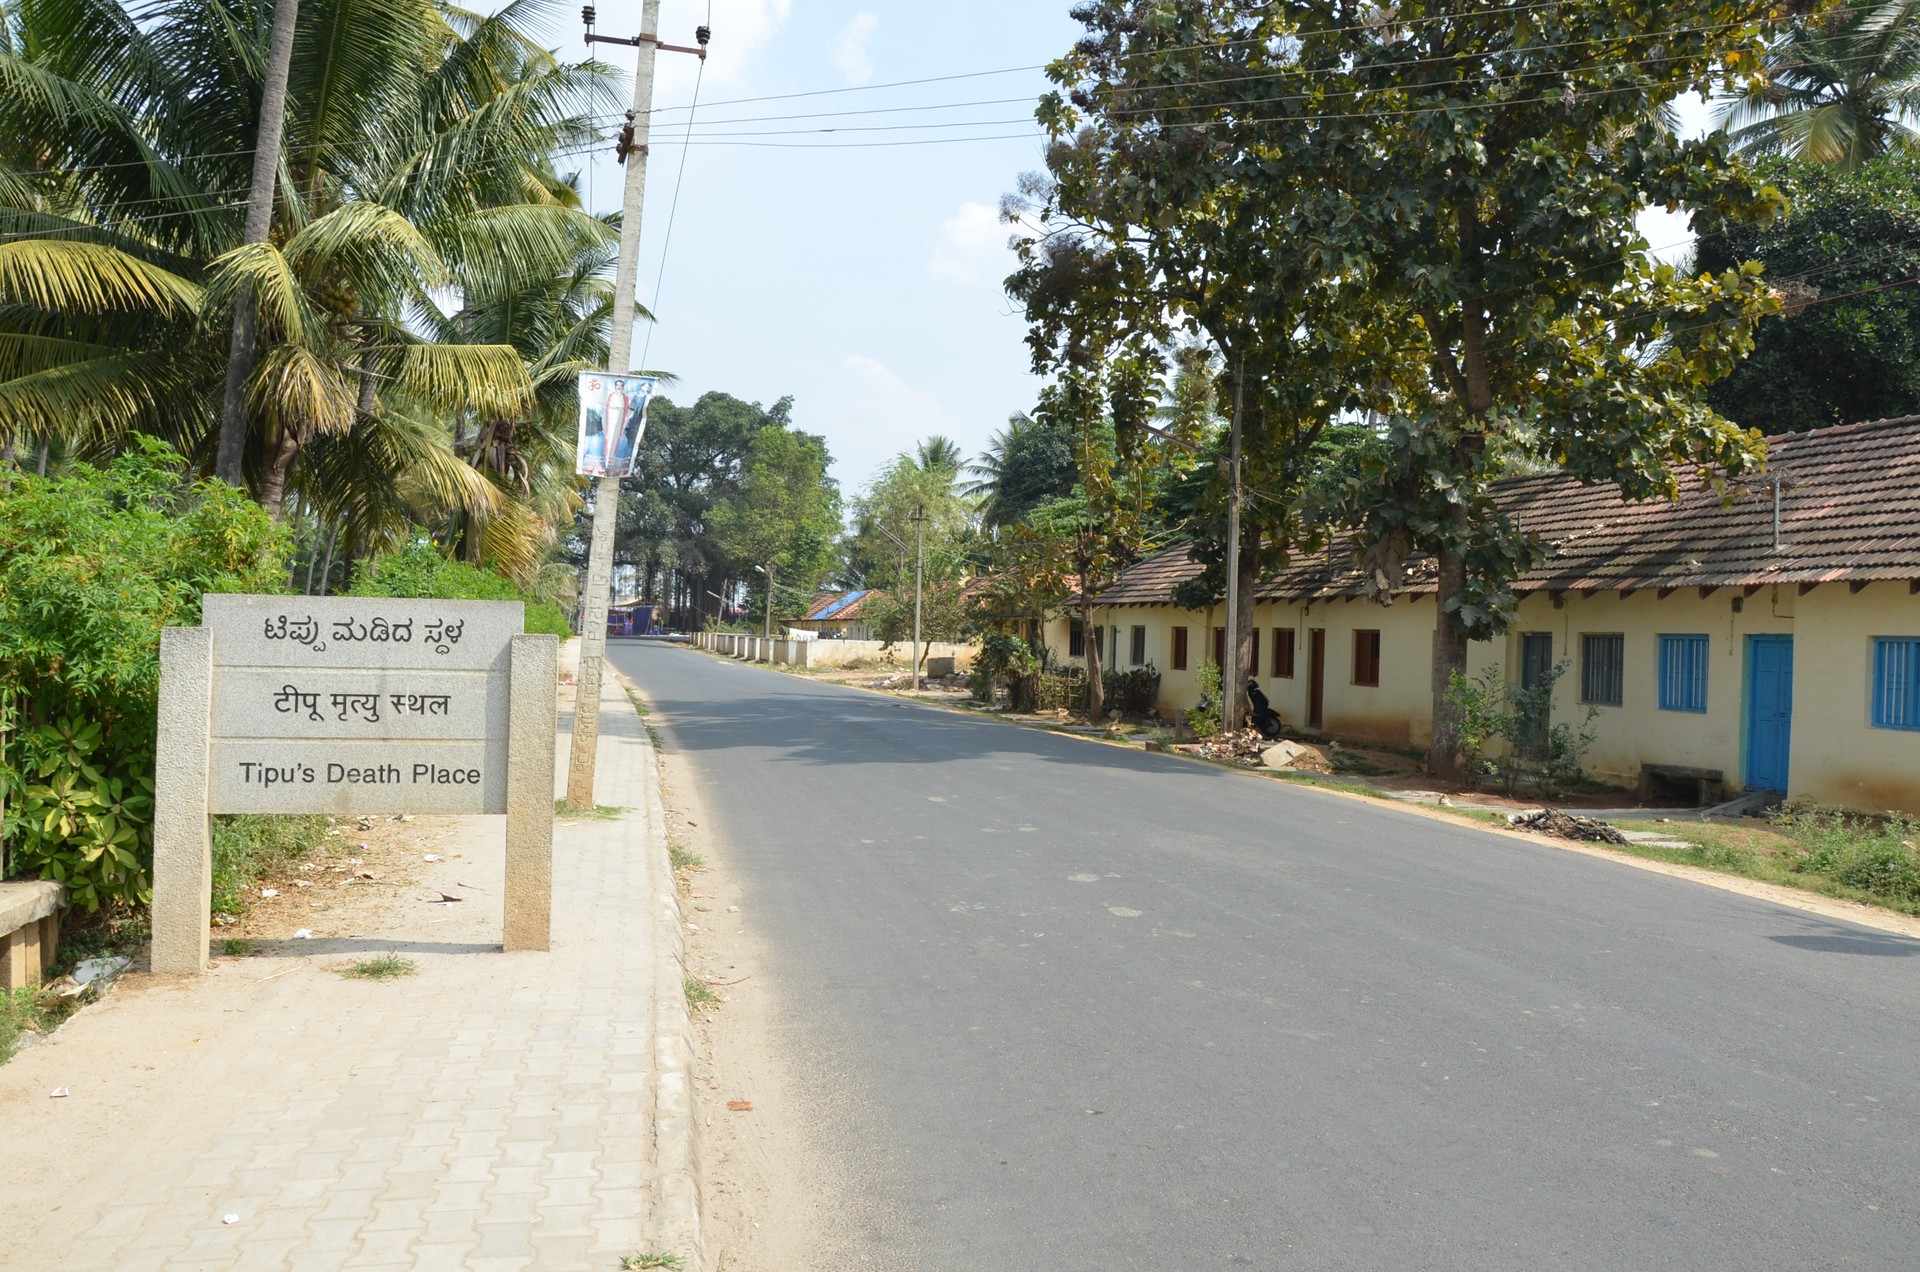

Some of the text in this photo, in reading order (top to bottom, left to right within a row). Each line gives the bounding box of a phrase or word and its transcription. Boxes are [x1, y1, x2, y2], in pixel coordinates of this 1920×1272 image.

[264, 614, 326, 652] ಟಿಪ್ಪು
[332, 616, 413, 643] ಮಡಿದ
[273, 684, 452, 723] टीपू मृत्यु स्थल
[239, 762, 482, 788] Tipu's Death Place
